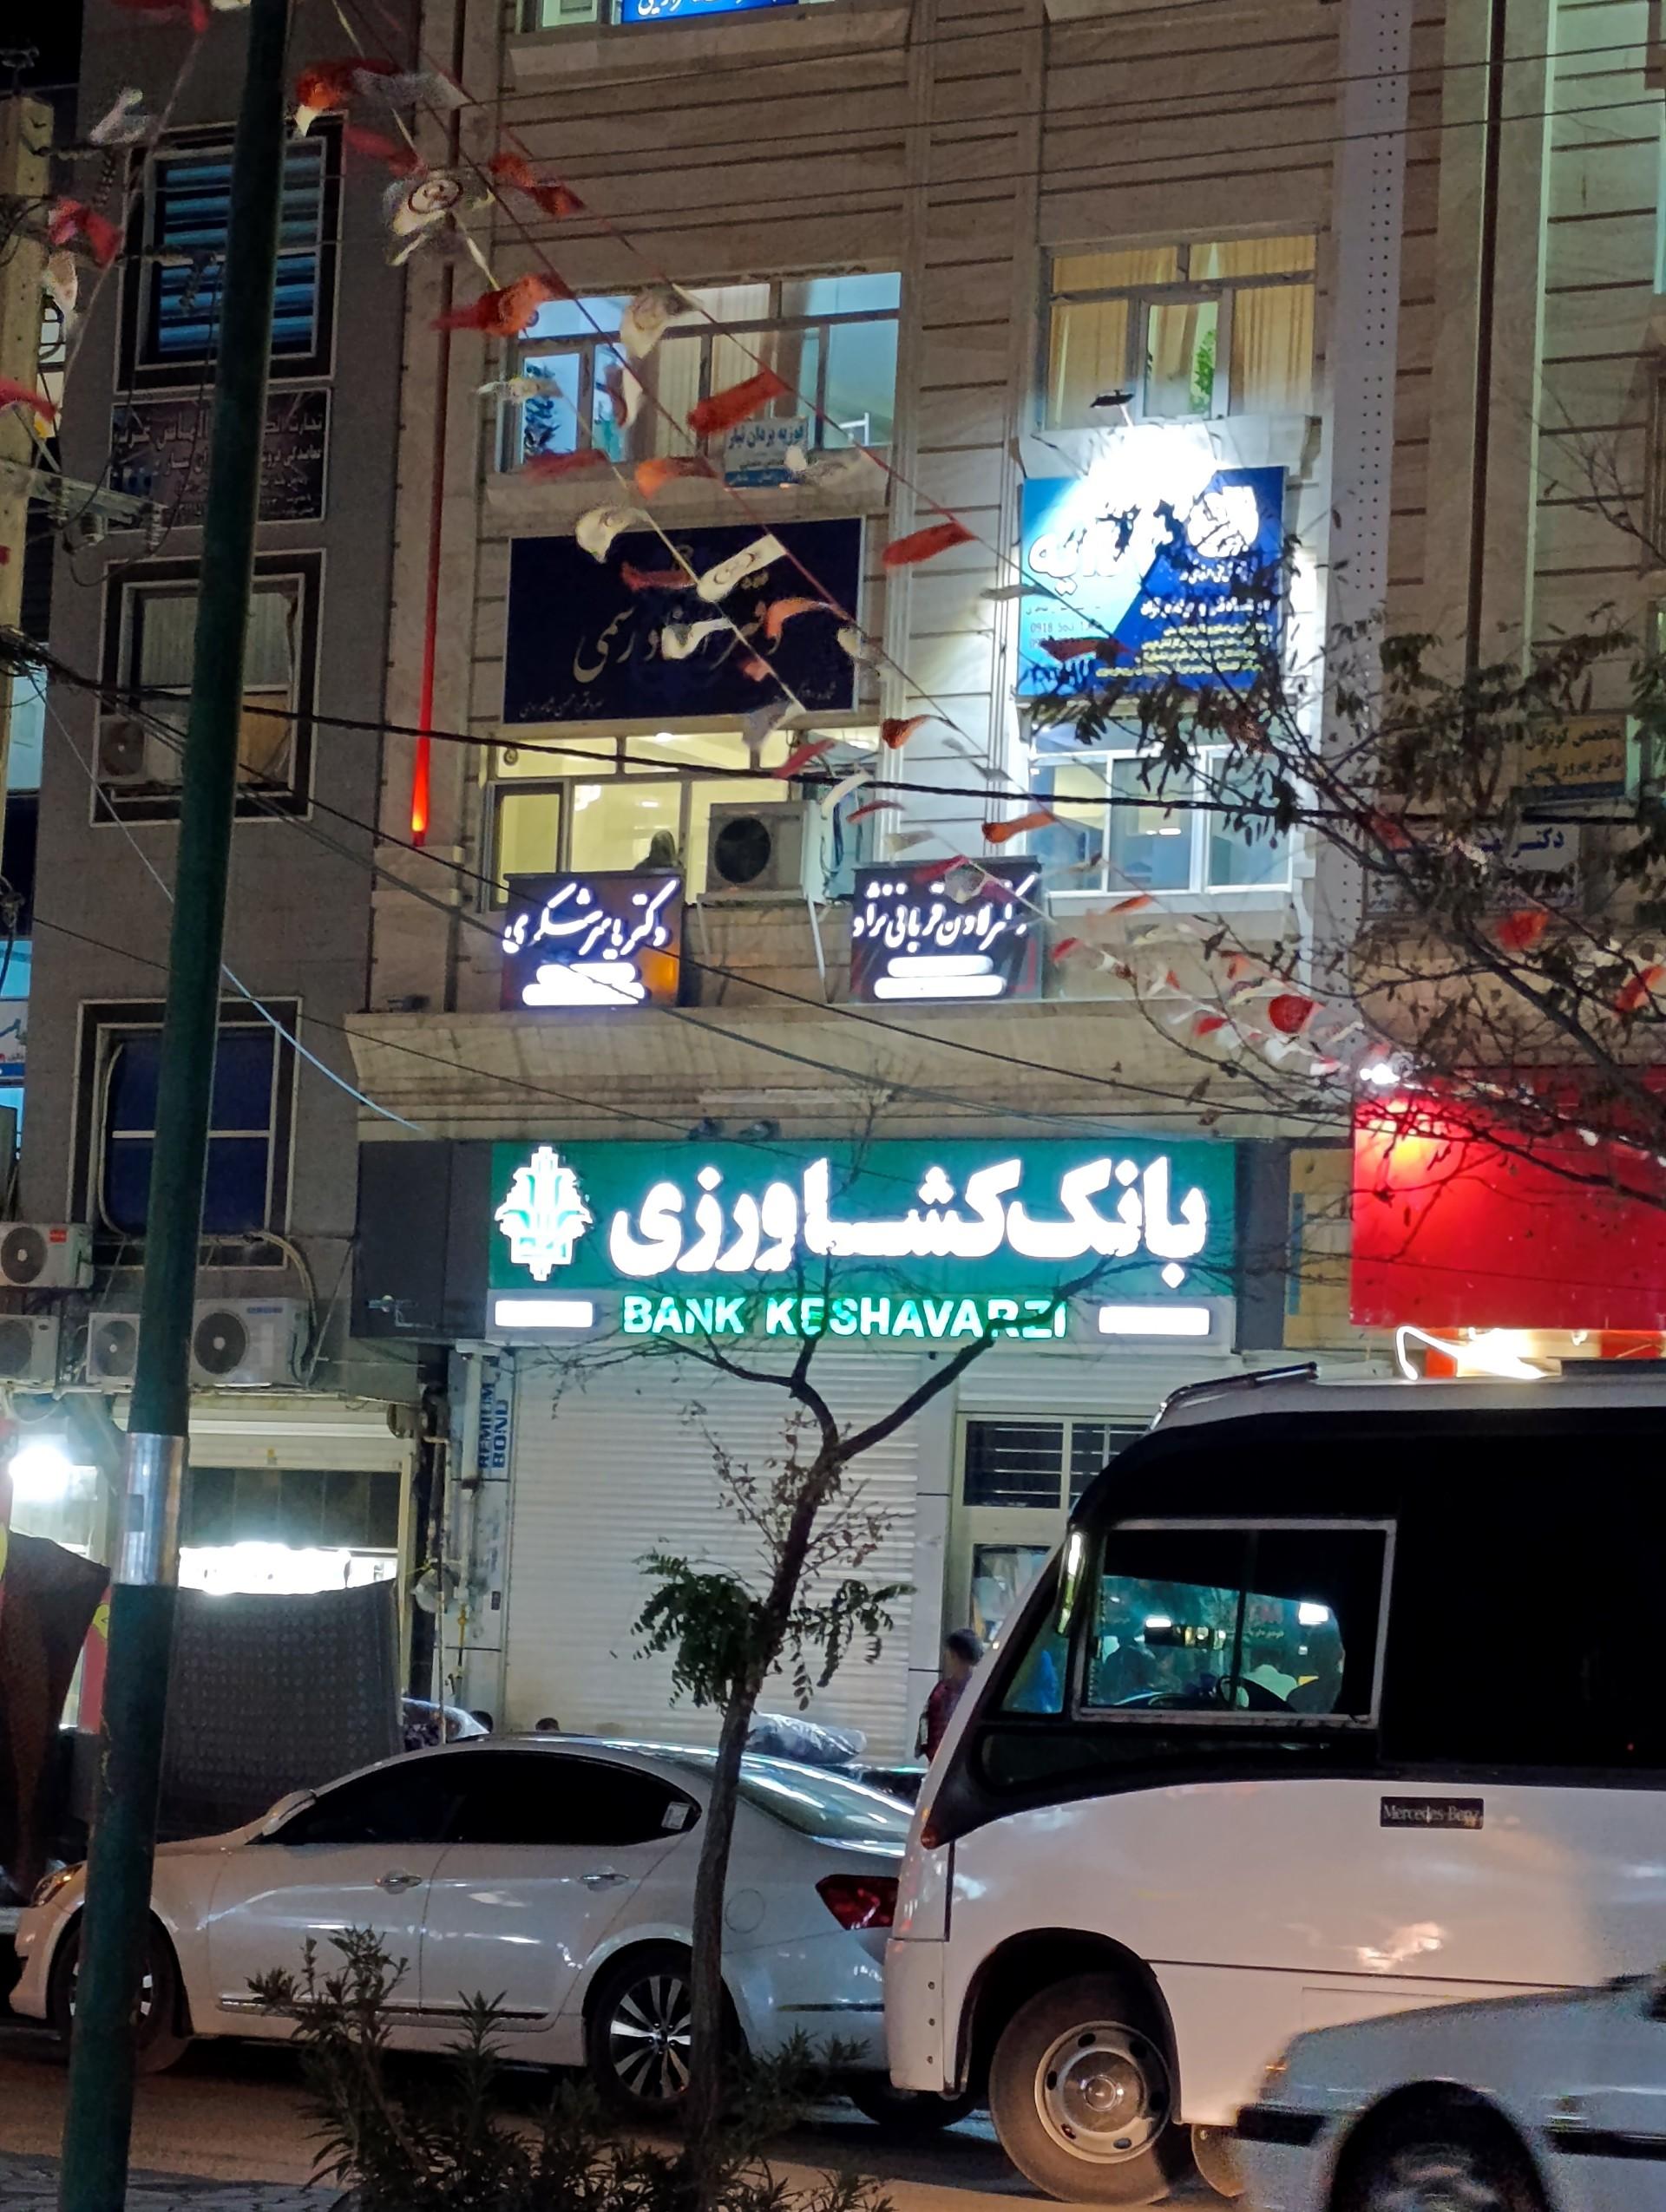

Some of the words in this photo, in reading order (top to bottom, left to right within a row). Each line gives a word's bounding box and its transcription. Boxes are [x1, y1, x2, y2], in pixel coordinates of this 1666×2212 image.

[620, 880, 677, 956] دکتر
[609, 1158, 1023, 1277] کشاورزی
[1007, 1155, 1209, 1290] بانک
[622, 1295, 745, 1337] BANK
[765, 1295, 1067, 1339] KESHAVARZI
[494, 1398, 509, 1468] BOND
